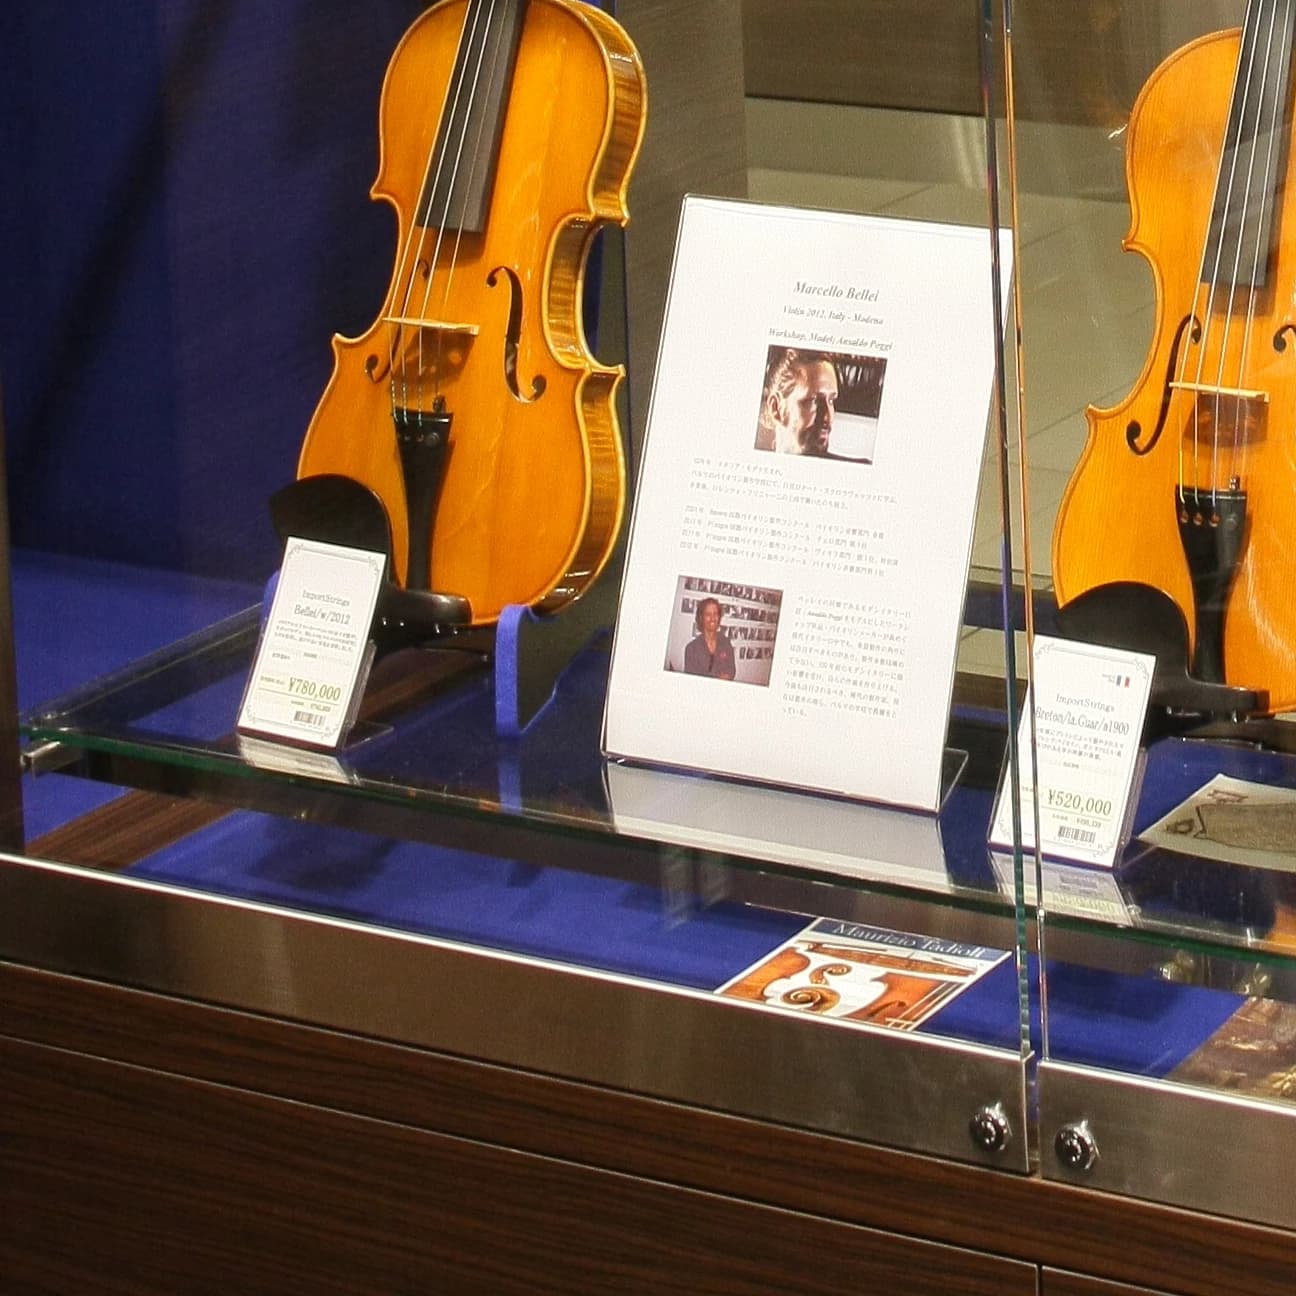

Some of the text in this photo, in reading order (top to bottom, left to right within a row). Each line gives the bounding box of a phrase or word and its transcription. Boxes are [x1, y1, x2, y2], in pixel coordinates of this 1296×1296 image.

[793, 281, 880, 302] Marcello Bellei
[288, 677, 342, 701] ¥780,000
[1055, 693, 1115, 713] ImportStrings
[1049, 789, 1112, 816] ¥520,000
[833, 923, 917, 947] Maurizio
